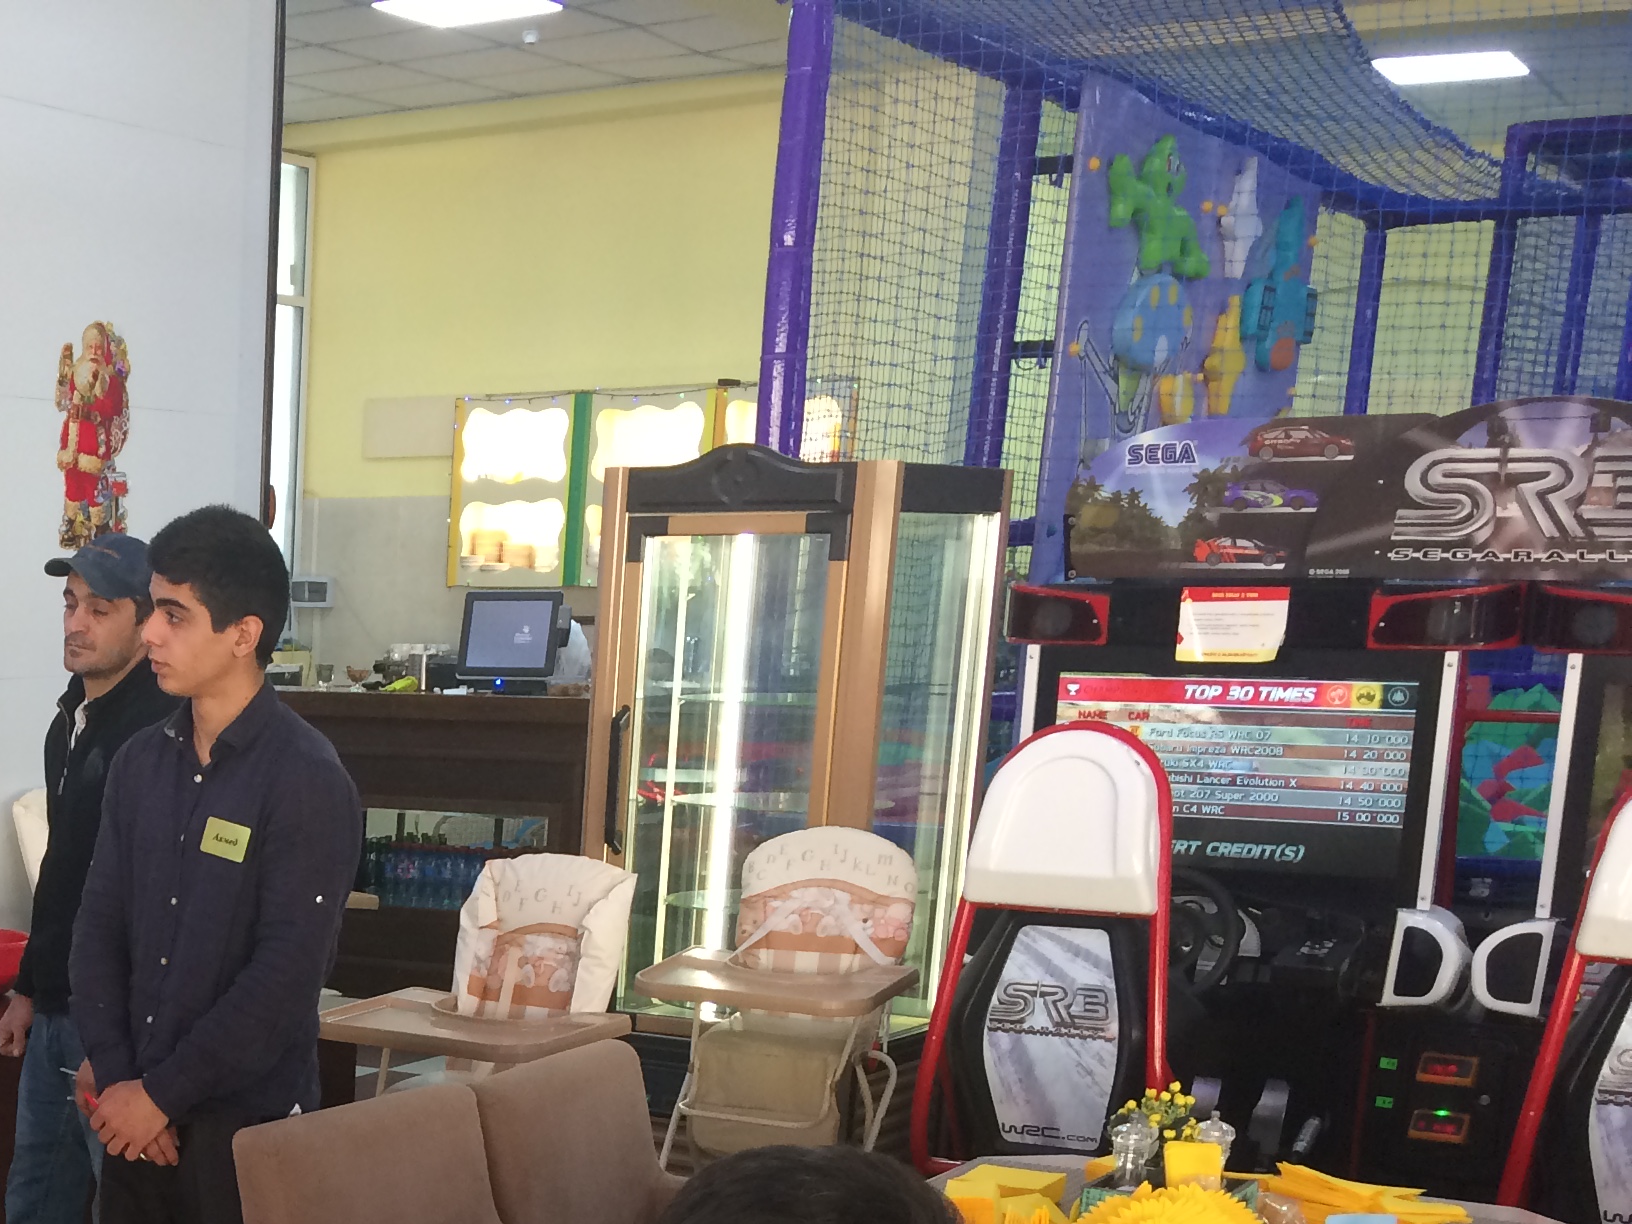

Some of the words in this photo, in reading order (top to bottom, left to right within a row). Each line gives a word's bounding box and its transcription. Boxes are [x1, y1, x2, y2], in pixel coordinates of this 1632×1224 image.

[1126, 441, 1197, 466] SEGA
[1184, 684, 1223, 700] TOP
[1226, 685, 1255, 701] 30
[1258, 686, 1318, 703] TIMES
[1078, 710, 1108, 720] NAME
[1127, 711, 1150, 721] CAR
[1196, 774, 1232, 785] Lancer
[1236, 775, 1285, 787] Evolution
[1189, 789, 1210, 799] 207
[1214, 791, 1245, 802] Super
[1249, 792, 1279, 802] 2000
[1182, 804, 1198, 813] C4
[1201, 805, 1225, 815] WRC
[1205, 841, 1306, 863] CREDIT(S)
